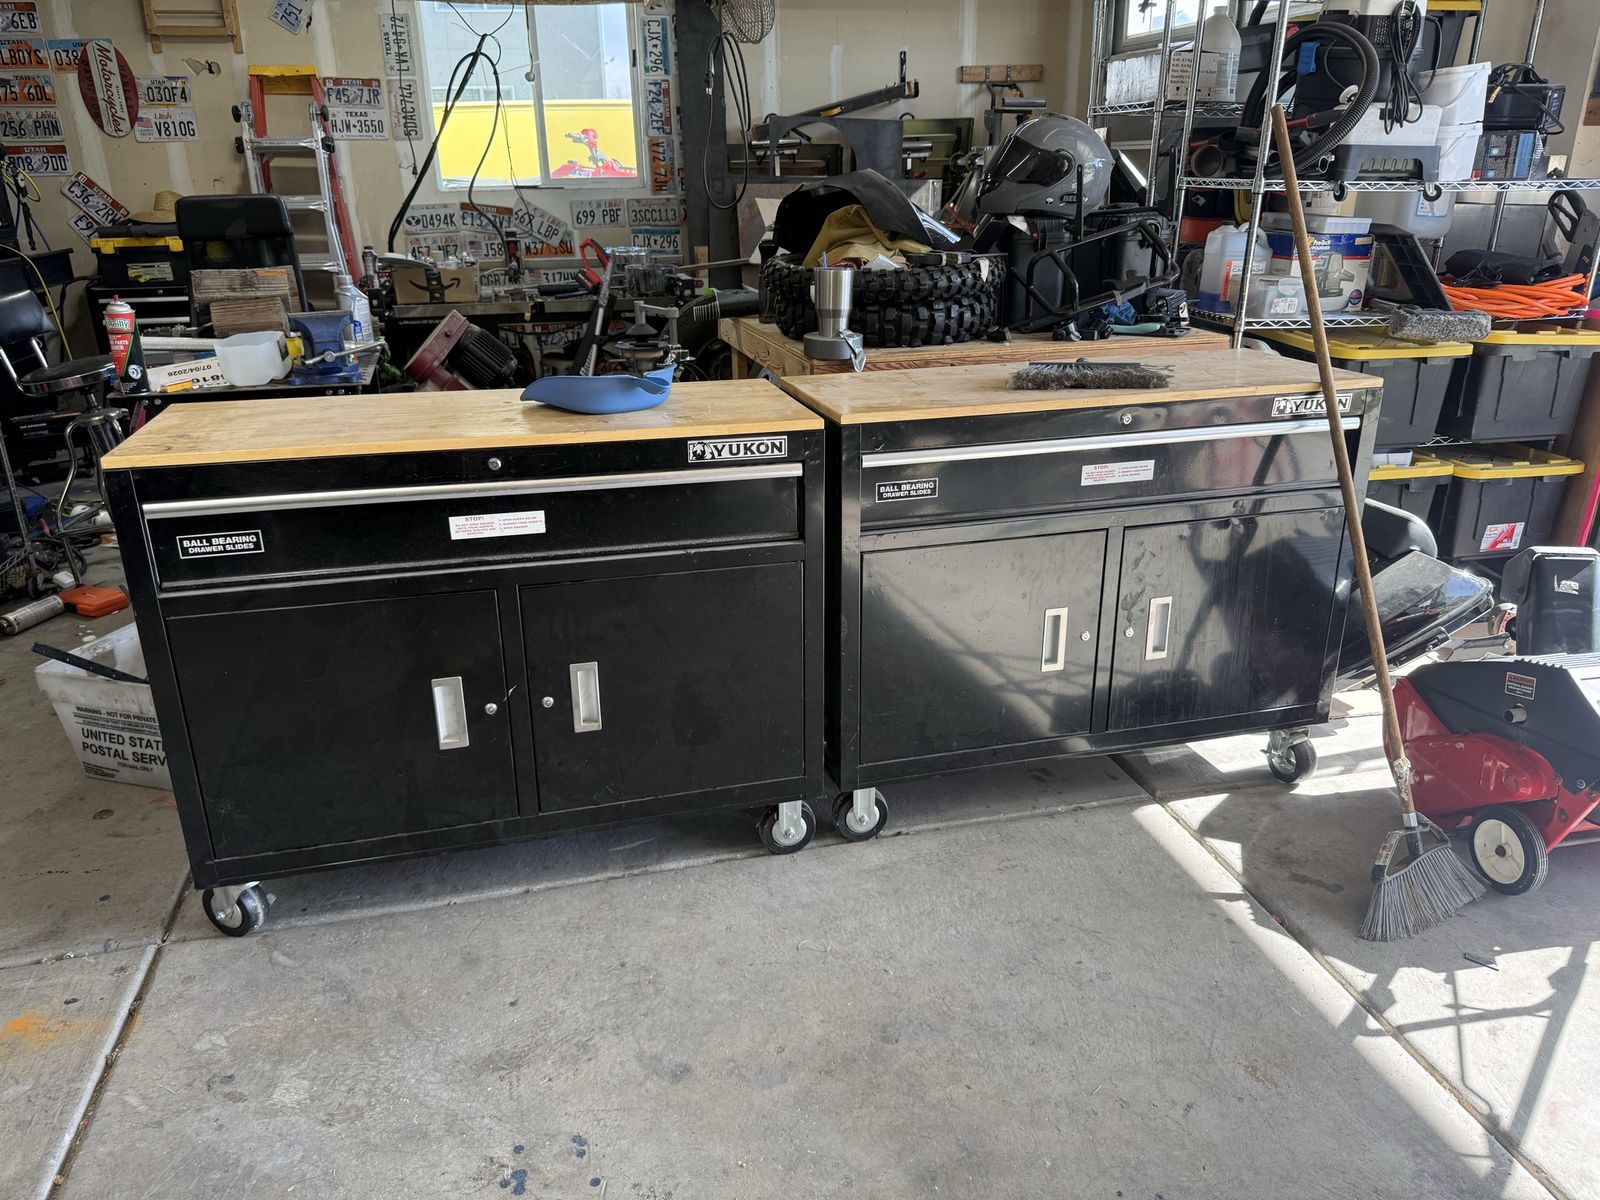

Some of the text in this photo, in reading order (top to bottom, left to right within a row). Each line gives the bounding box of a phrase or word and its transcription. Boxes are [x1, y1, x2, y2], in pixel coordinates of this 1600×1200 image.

[12, 12, 37, 29] 6EB
[647, 20, 661, 42] CJX
[383, 32, 392, 56] TEXAS
[649, 50, 663, 72] 296
[95, 41, 126, 136] Motorcycles
[327, 88, 380, 104] F45 7JR
[0, 120, 60, 136] 256 PHN
[154, 120, 196, 136] V810G
[331, 120, 384, 134] HJW 3550
[422, 212, 457, 229] D494K
[576, 208, 622, 224] 699 PBF
[660, 235, 678, 249] 296
[1293, 398, 1348, 412] YUKN
[712, 441, 783, 456] YUKON
[880, 482, 934, 494] BALL BEARING
[882, 490, 910, 498] DRAWER
[182, 534, 257, 548] BALL BEARING
[188, 542, 254, 554] DRAWER SLIDES
[76, 706, 102, 716] WARNING
[119, 712, 132, 720] FOR
[133, 714, 156, 724] PRIVATE
[82, 728, 165, 752] UNITED STAT
[82, 742, 129, 761] POSTAL
